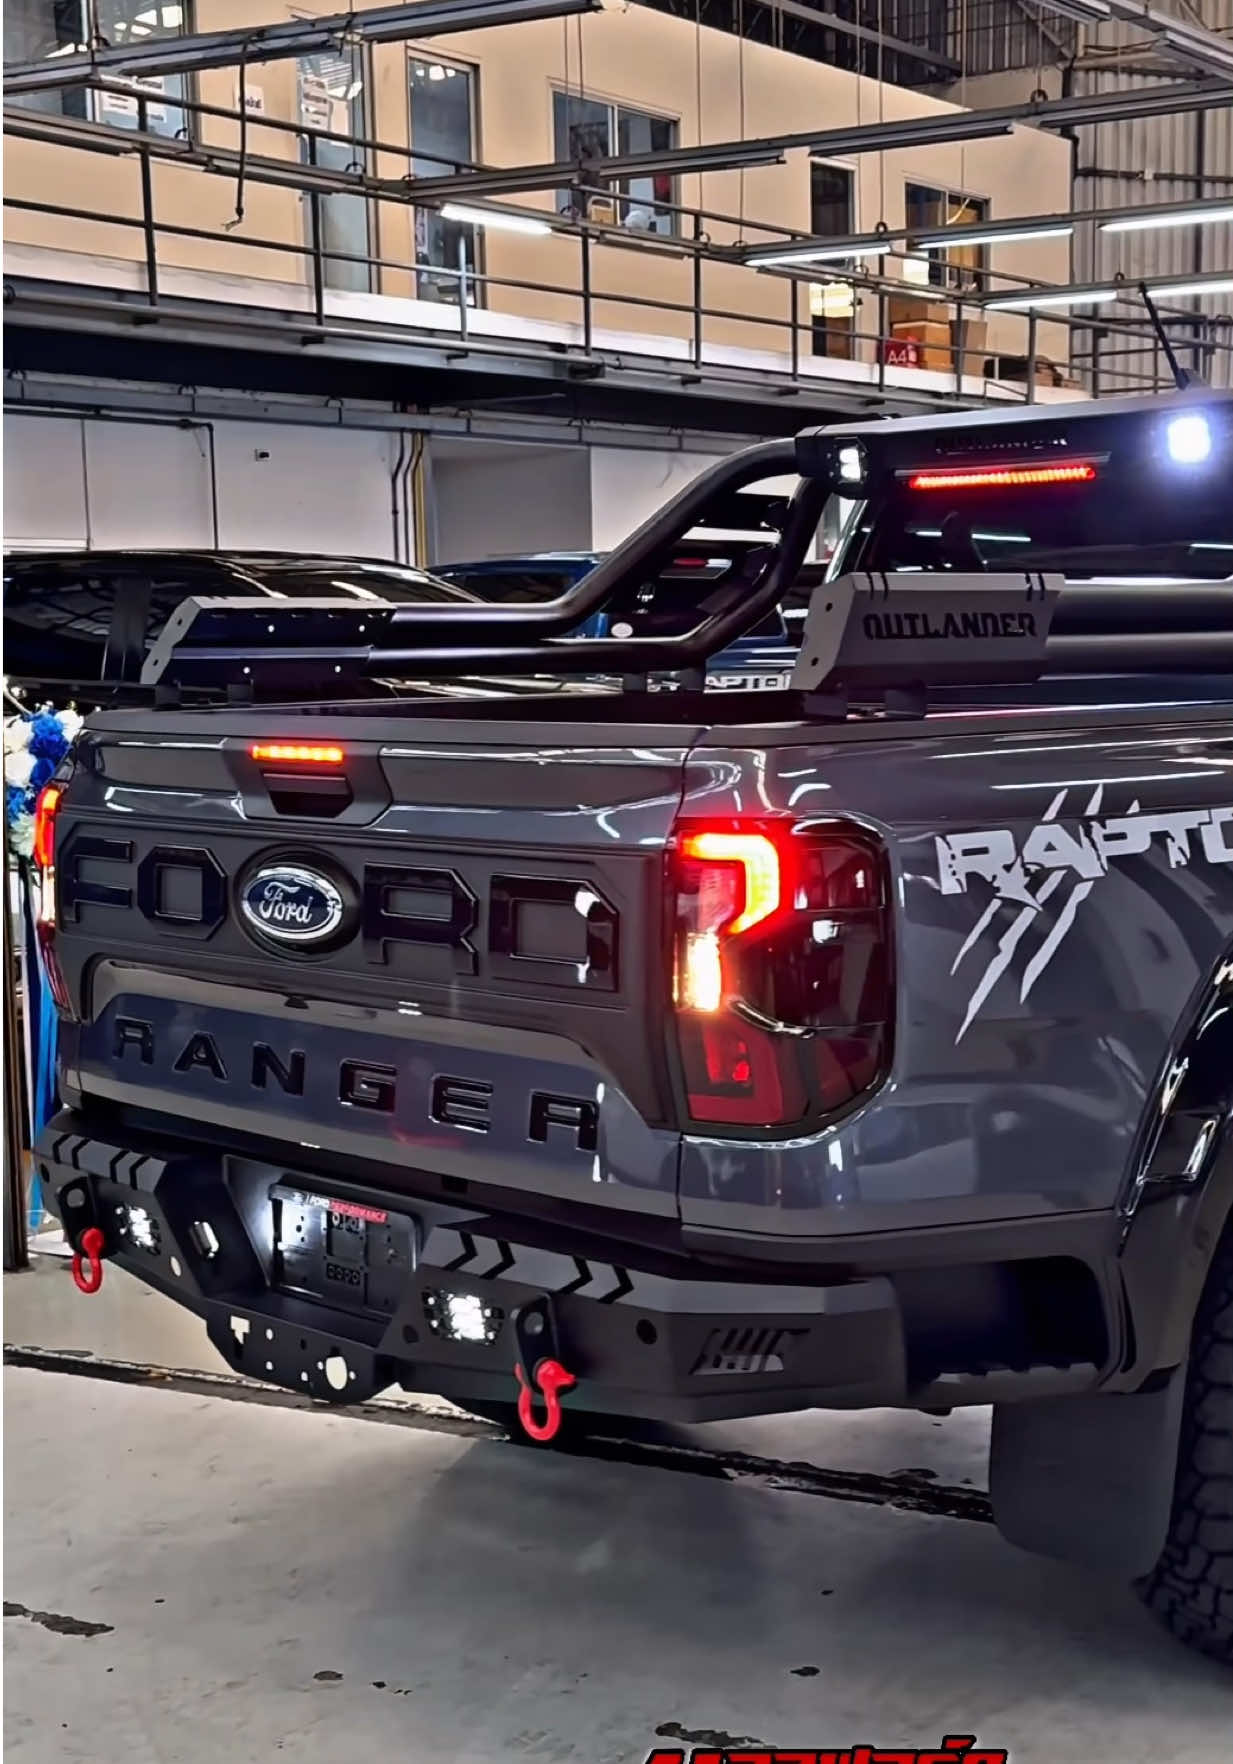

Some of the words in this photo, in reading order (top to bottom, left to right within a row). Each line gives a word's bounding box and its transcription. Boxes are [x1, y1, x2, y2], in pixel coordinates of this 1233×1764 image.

[862, 612, 1038, 639] OUTLANDER
[58, 836, 620, 992] FORD
[259, 881, 315, 924] Ford
[112, 1014, 599, 1152] RANGER
